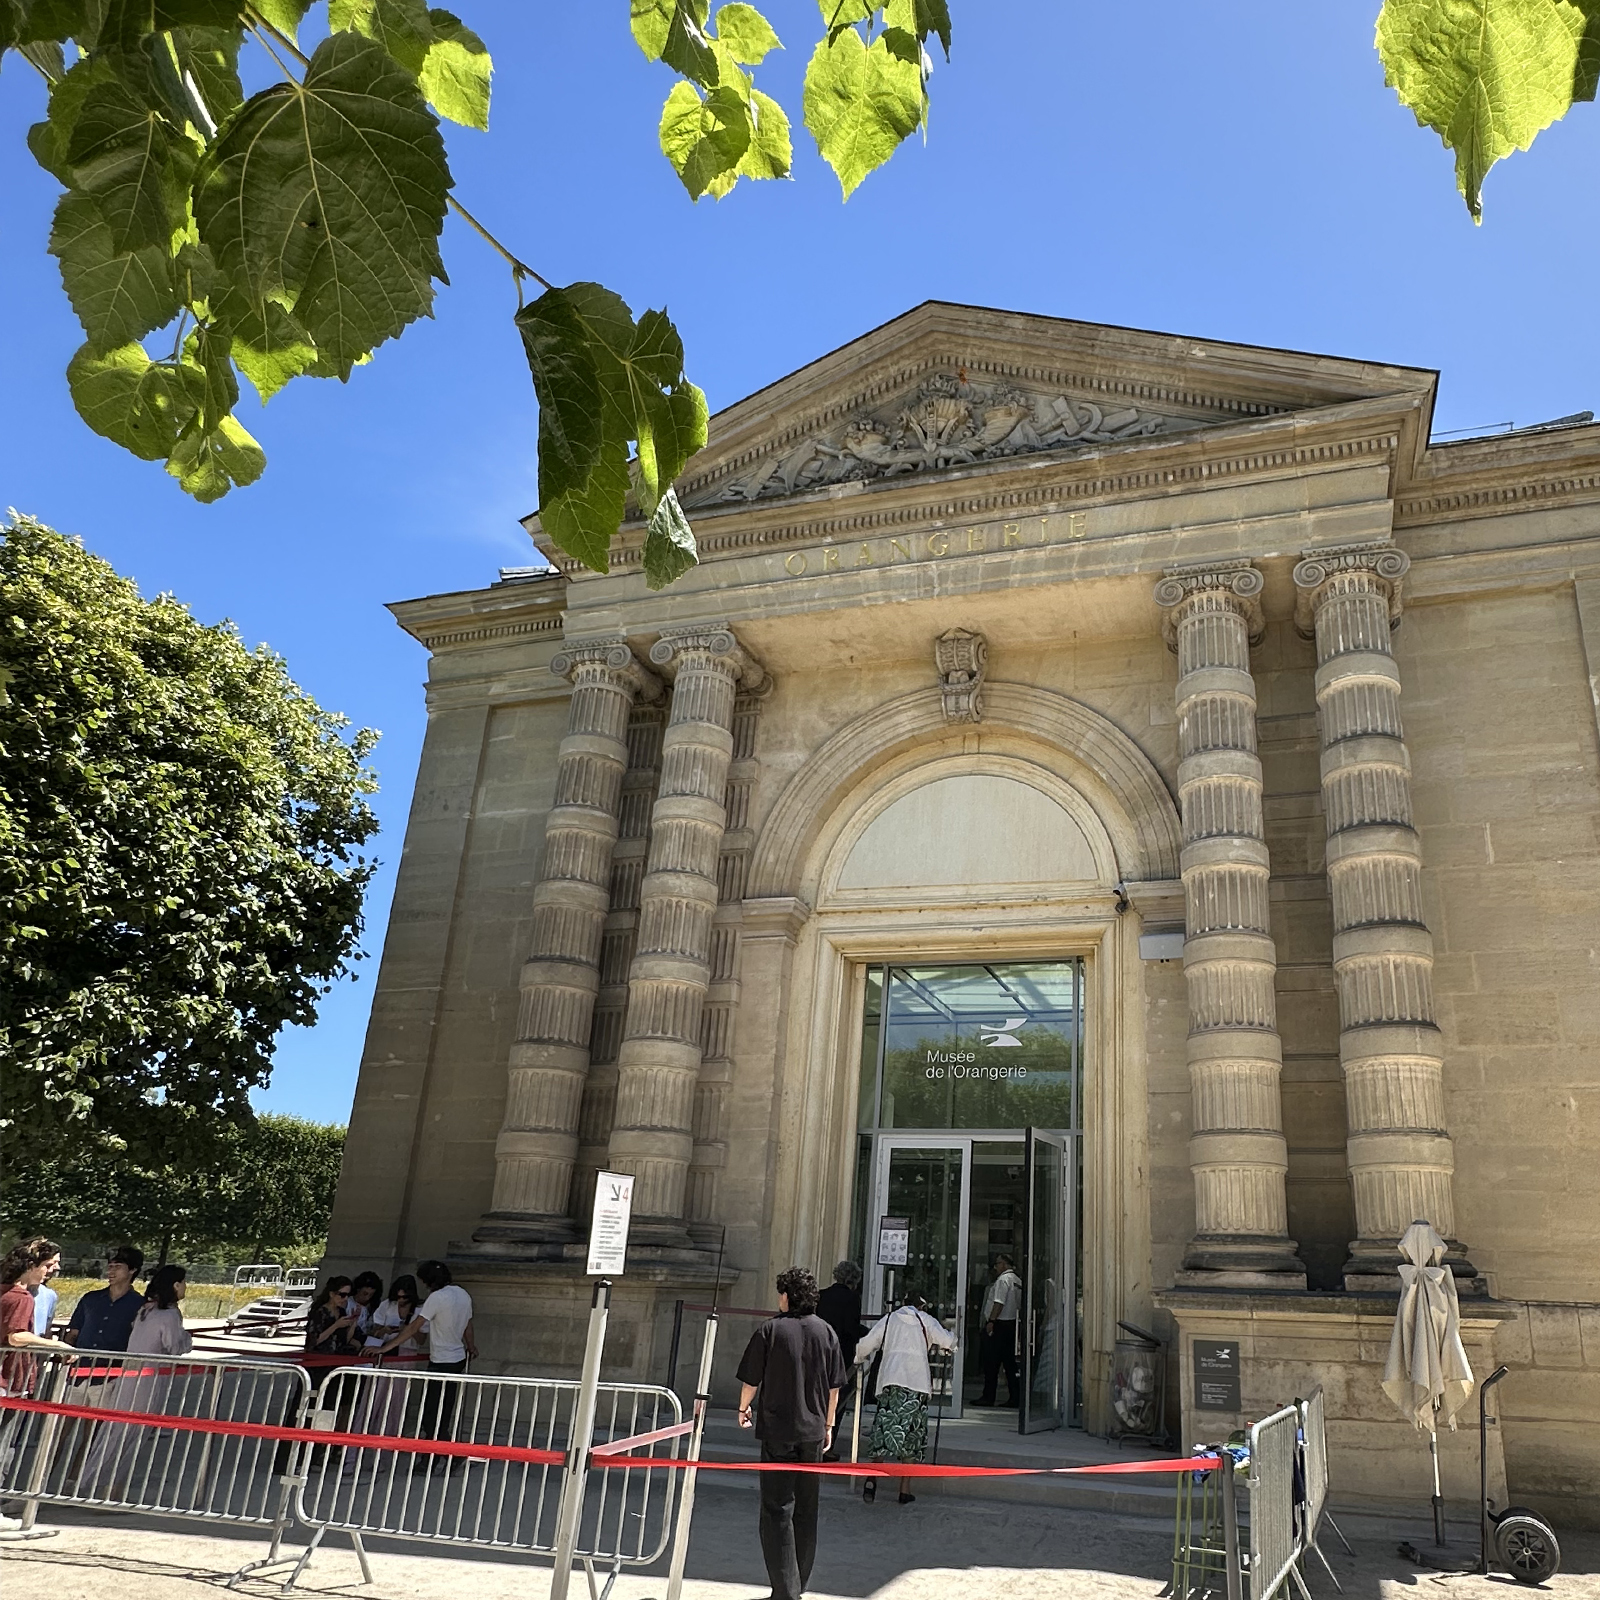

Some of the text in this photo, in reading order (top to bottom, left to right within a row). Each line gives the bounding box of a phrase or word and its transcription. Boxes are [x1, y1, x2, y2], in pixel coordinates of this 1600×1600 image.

[784, 512, 1087, 577] ORANGERIE
[926, 1049, 976, 1063] Musée
[925, 1064, 1027, 1080] de l'Orangerie
